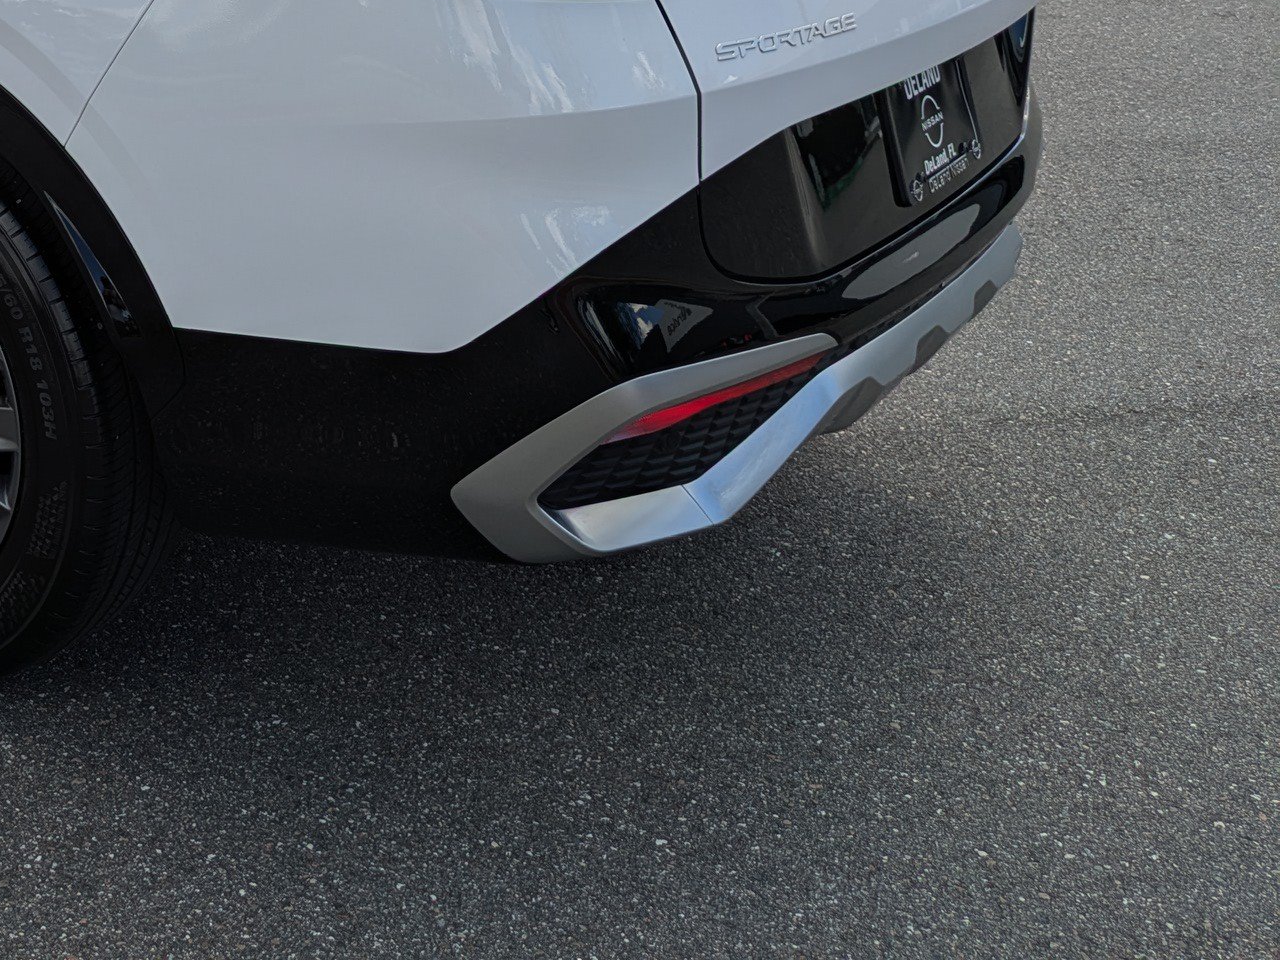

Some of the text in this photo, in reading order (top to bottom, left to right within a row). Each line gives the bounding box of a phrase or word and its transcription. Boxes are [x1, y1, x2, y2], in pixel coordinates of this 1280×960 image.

[715, 12, 858, 61] SPORTAGE
[903, 65, 941, 100] DELAND
[921, 111, 944, 131] NISSAN
[947, 143, 957, 159] FL
[16, 325, 43, 372] R18
[35, 379, 58, 440] 103H
